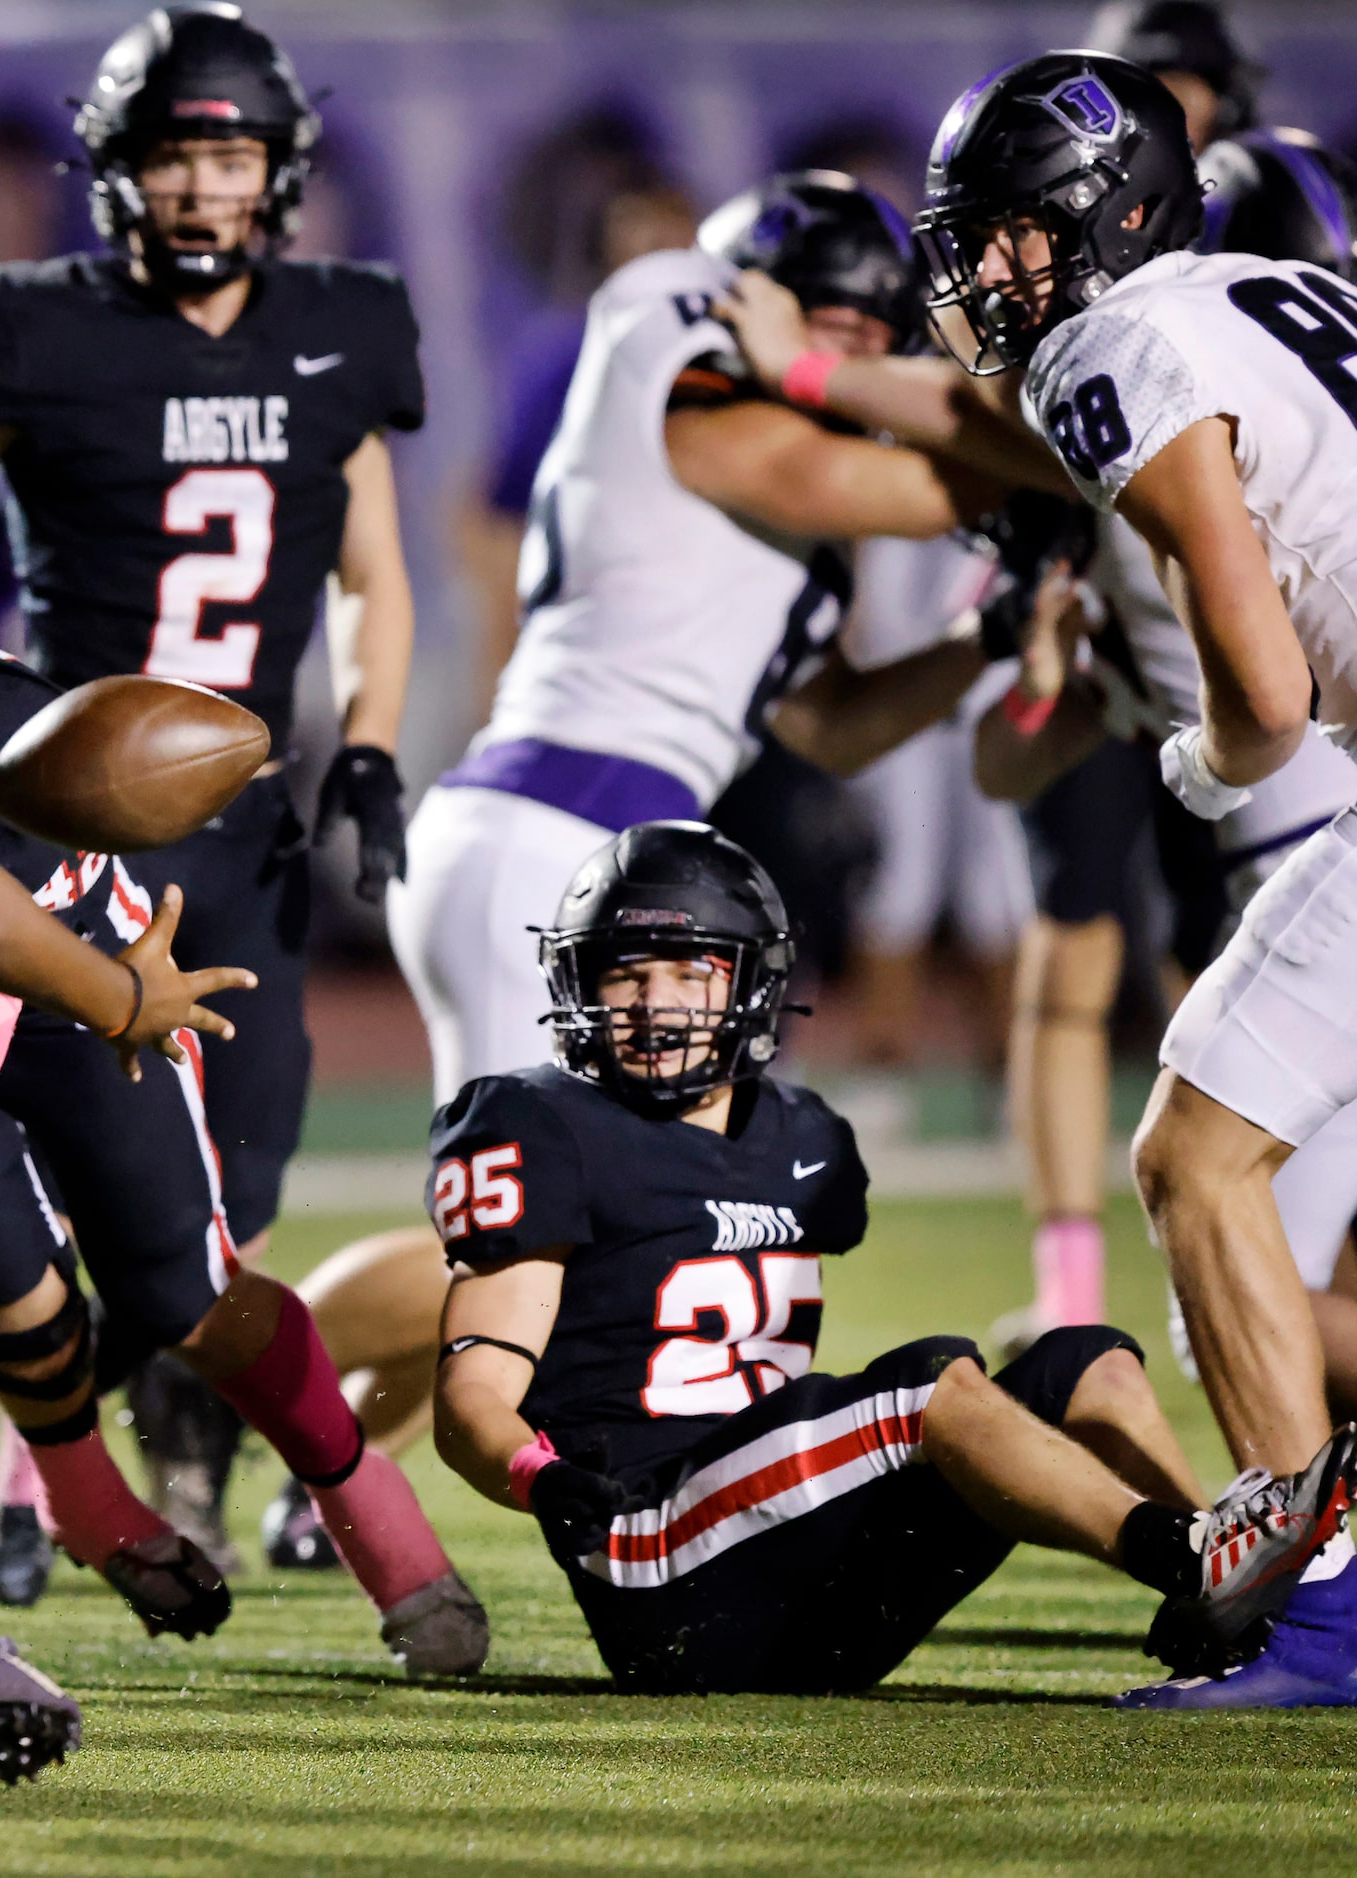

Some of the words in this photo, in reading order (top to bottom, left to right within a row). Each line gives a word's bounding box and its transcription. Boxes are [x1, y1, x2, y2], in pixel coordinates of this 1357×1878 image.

[161, 396, 289, 463] ARGYLE
[143, 466, 276, 690] 2
[434, 1141, 525, 1240] 25
[639, 1251, 824, 1418] 25
